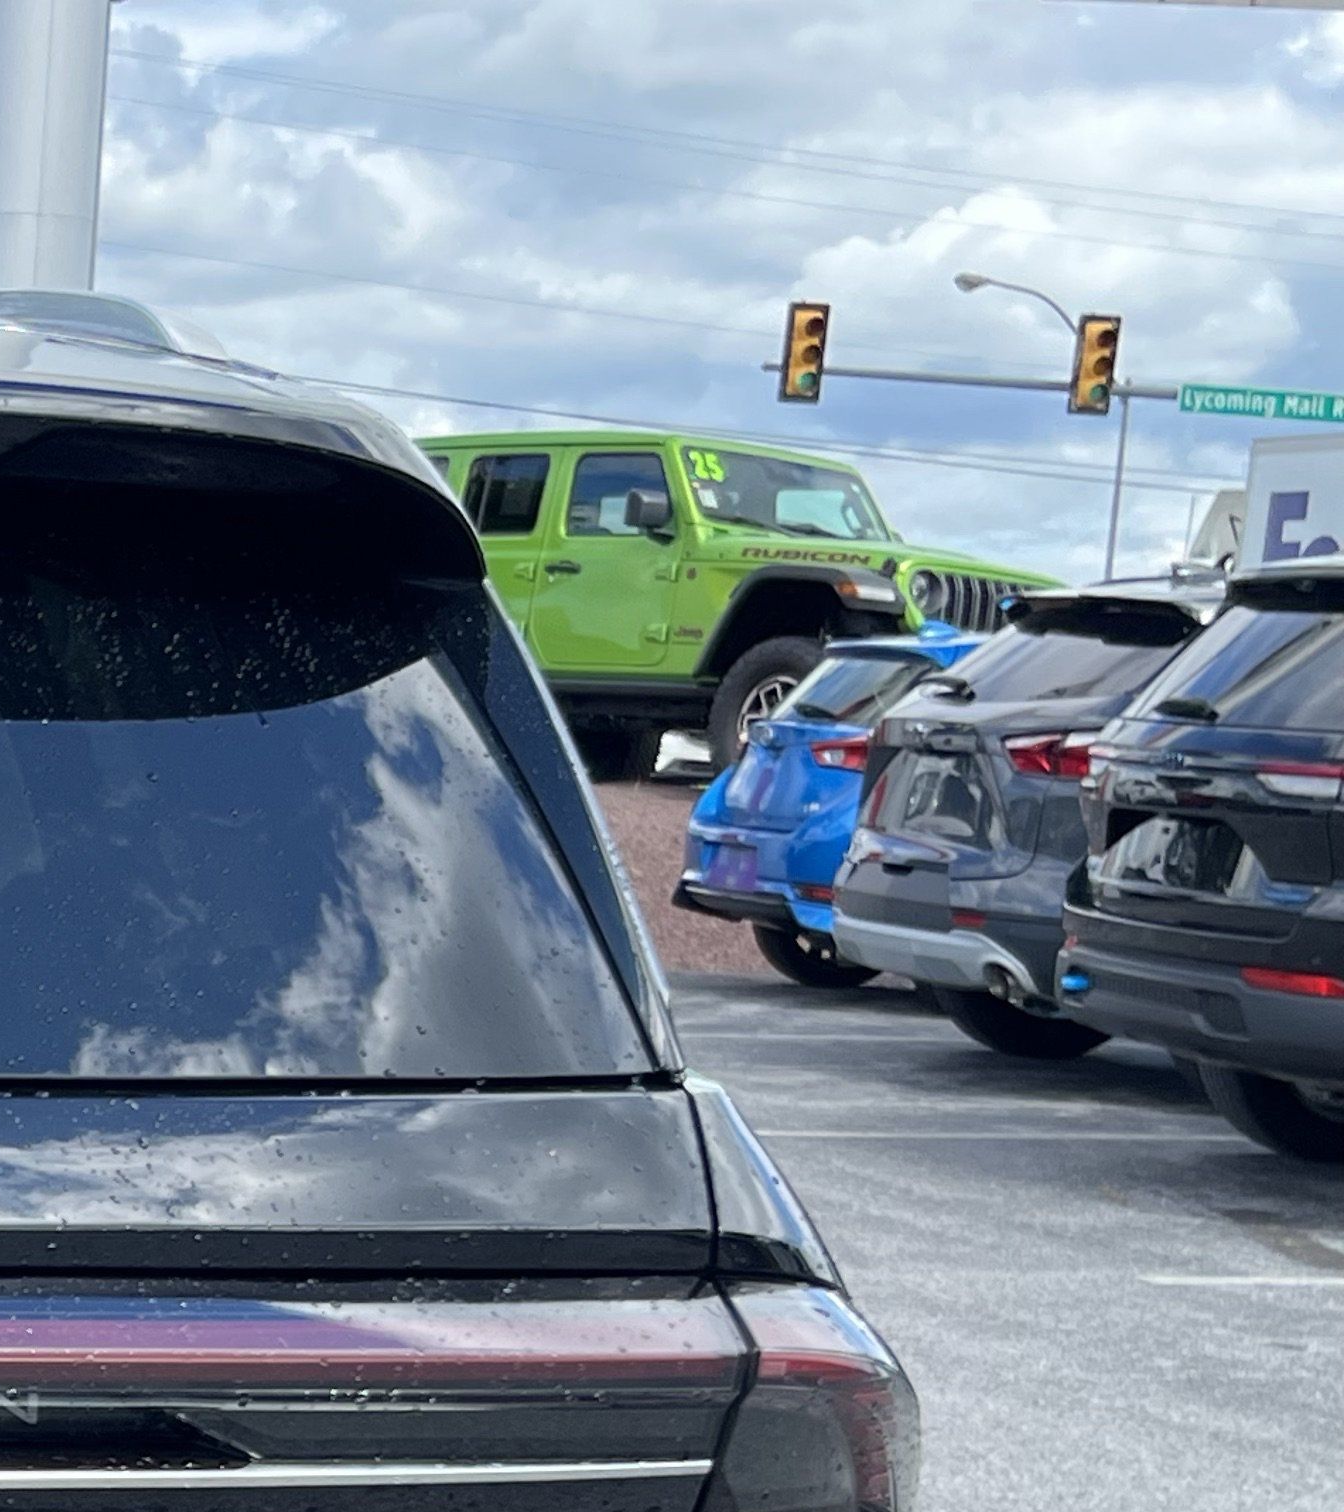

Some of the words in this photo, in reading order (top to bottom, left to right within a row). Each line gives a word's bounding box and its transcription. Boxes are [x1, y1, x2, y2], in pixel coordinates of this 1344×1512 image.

[1184, 388, 1277, 418] Lycoming
[1283, 394, 1325, 418] Mall
[688, 450, 725, 482] 25
[741, 546, 872, 566] RUBICON
